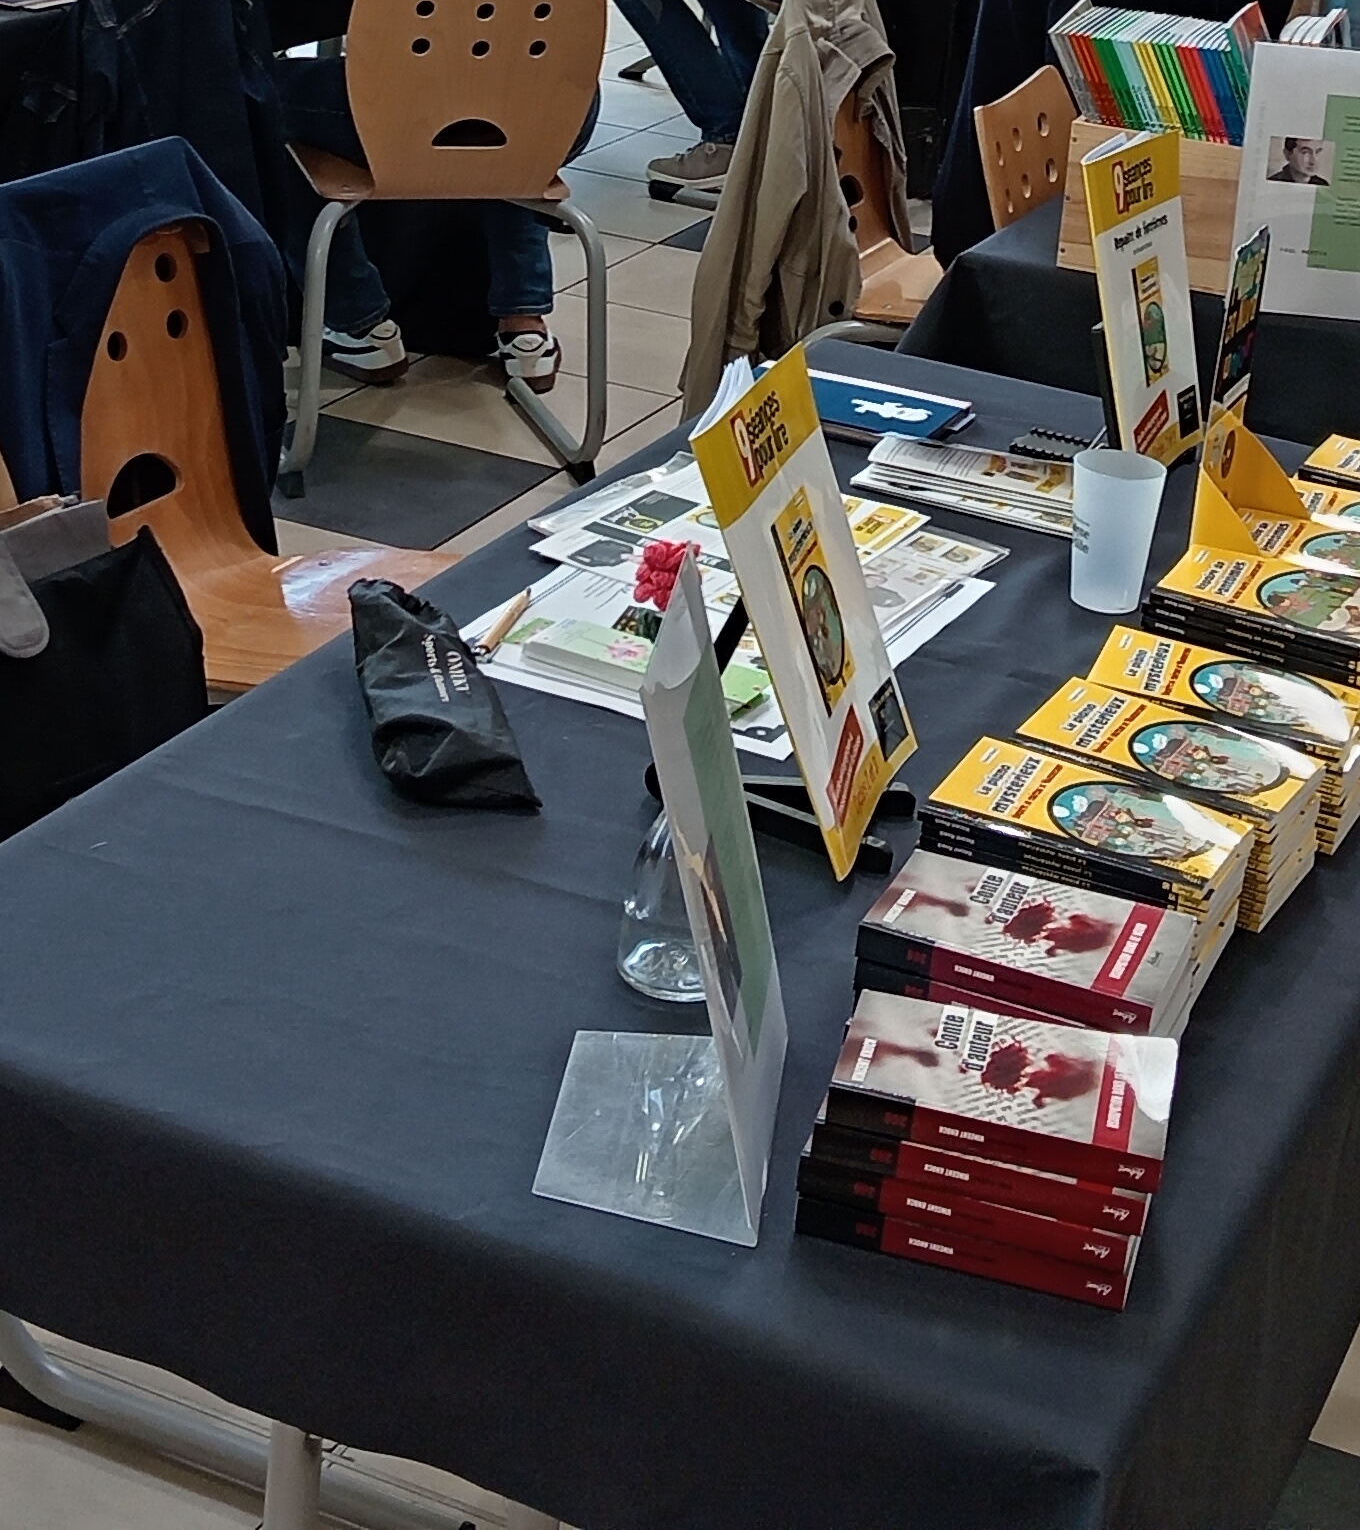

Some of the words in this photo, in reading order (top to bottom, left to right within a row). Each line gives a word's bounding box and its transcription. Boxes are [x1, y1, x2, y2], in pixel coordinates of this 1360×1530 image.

[969, 873, 1005, 905] Conte
[993, 881, 1030, 924] d'auteur
[934, 1013, 965, 1050] Conte
[961, 1020, 995, 1072] d'auteur
